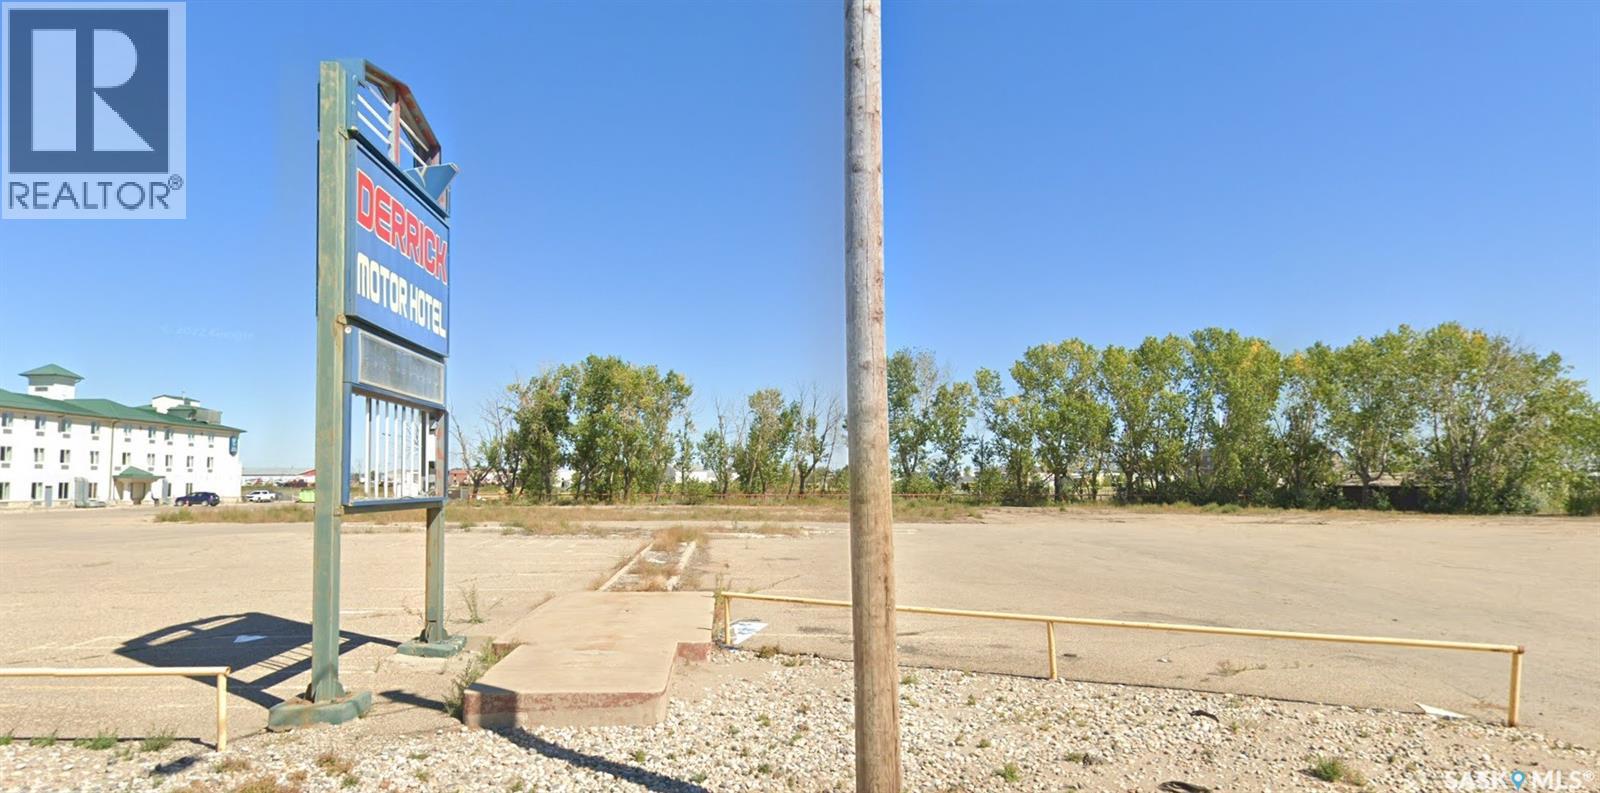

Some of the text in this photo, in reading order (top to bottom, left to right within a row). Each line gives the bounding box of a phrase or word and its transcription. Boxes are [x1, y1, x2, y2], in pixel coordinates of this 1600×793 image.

[356, 169, 447, 285] DERRICK
[356, 253, 447, 338] MOTOR HOTEL
